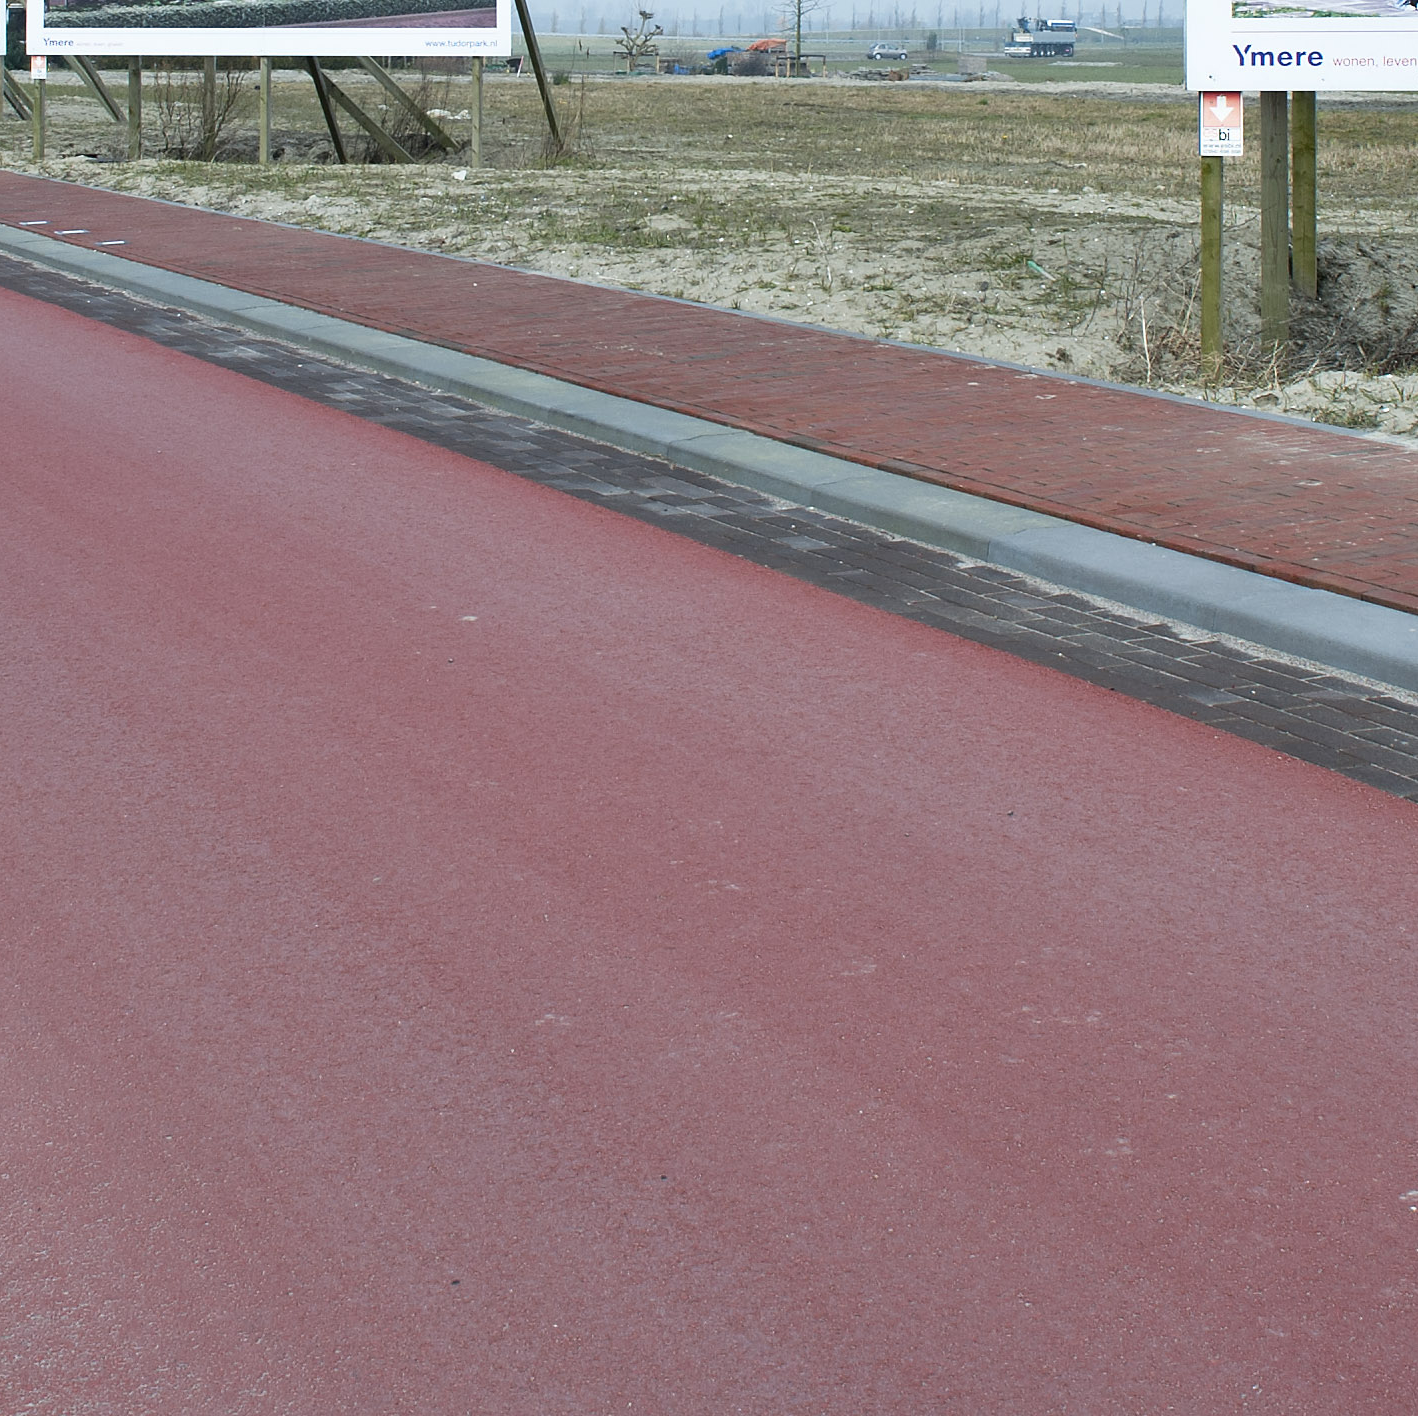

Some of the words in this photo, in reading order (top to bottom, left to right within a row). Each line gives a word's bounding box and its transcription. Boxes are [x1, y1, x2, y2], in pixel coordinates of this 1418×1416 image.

[43, 37, 74, 47] Ymere
[1232, 44, 1324, 67] Ymere
[1332, 57, 1379, 67] wonen,
